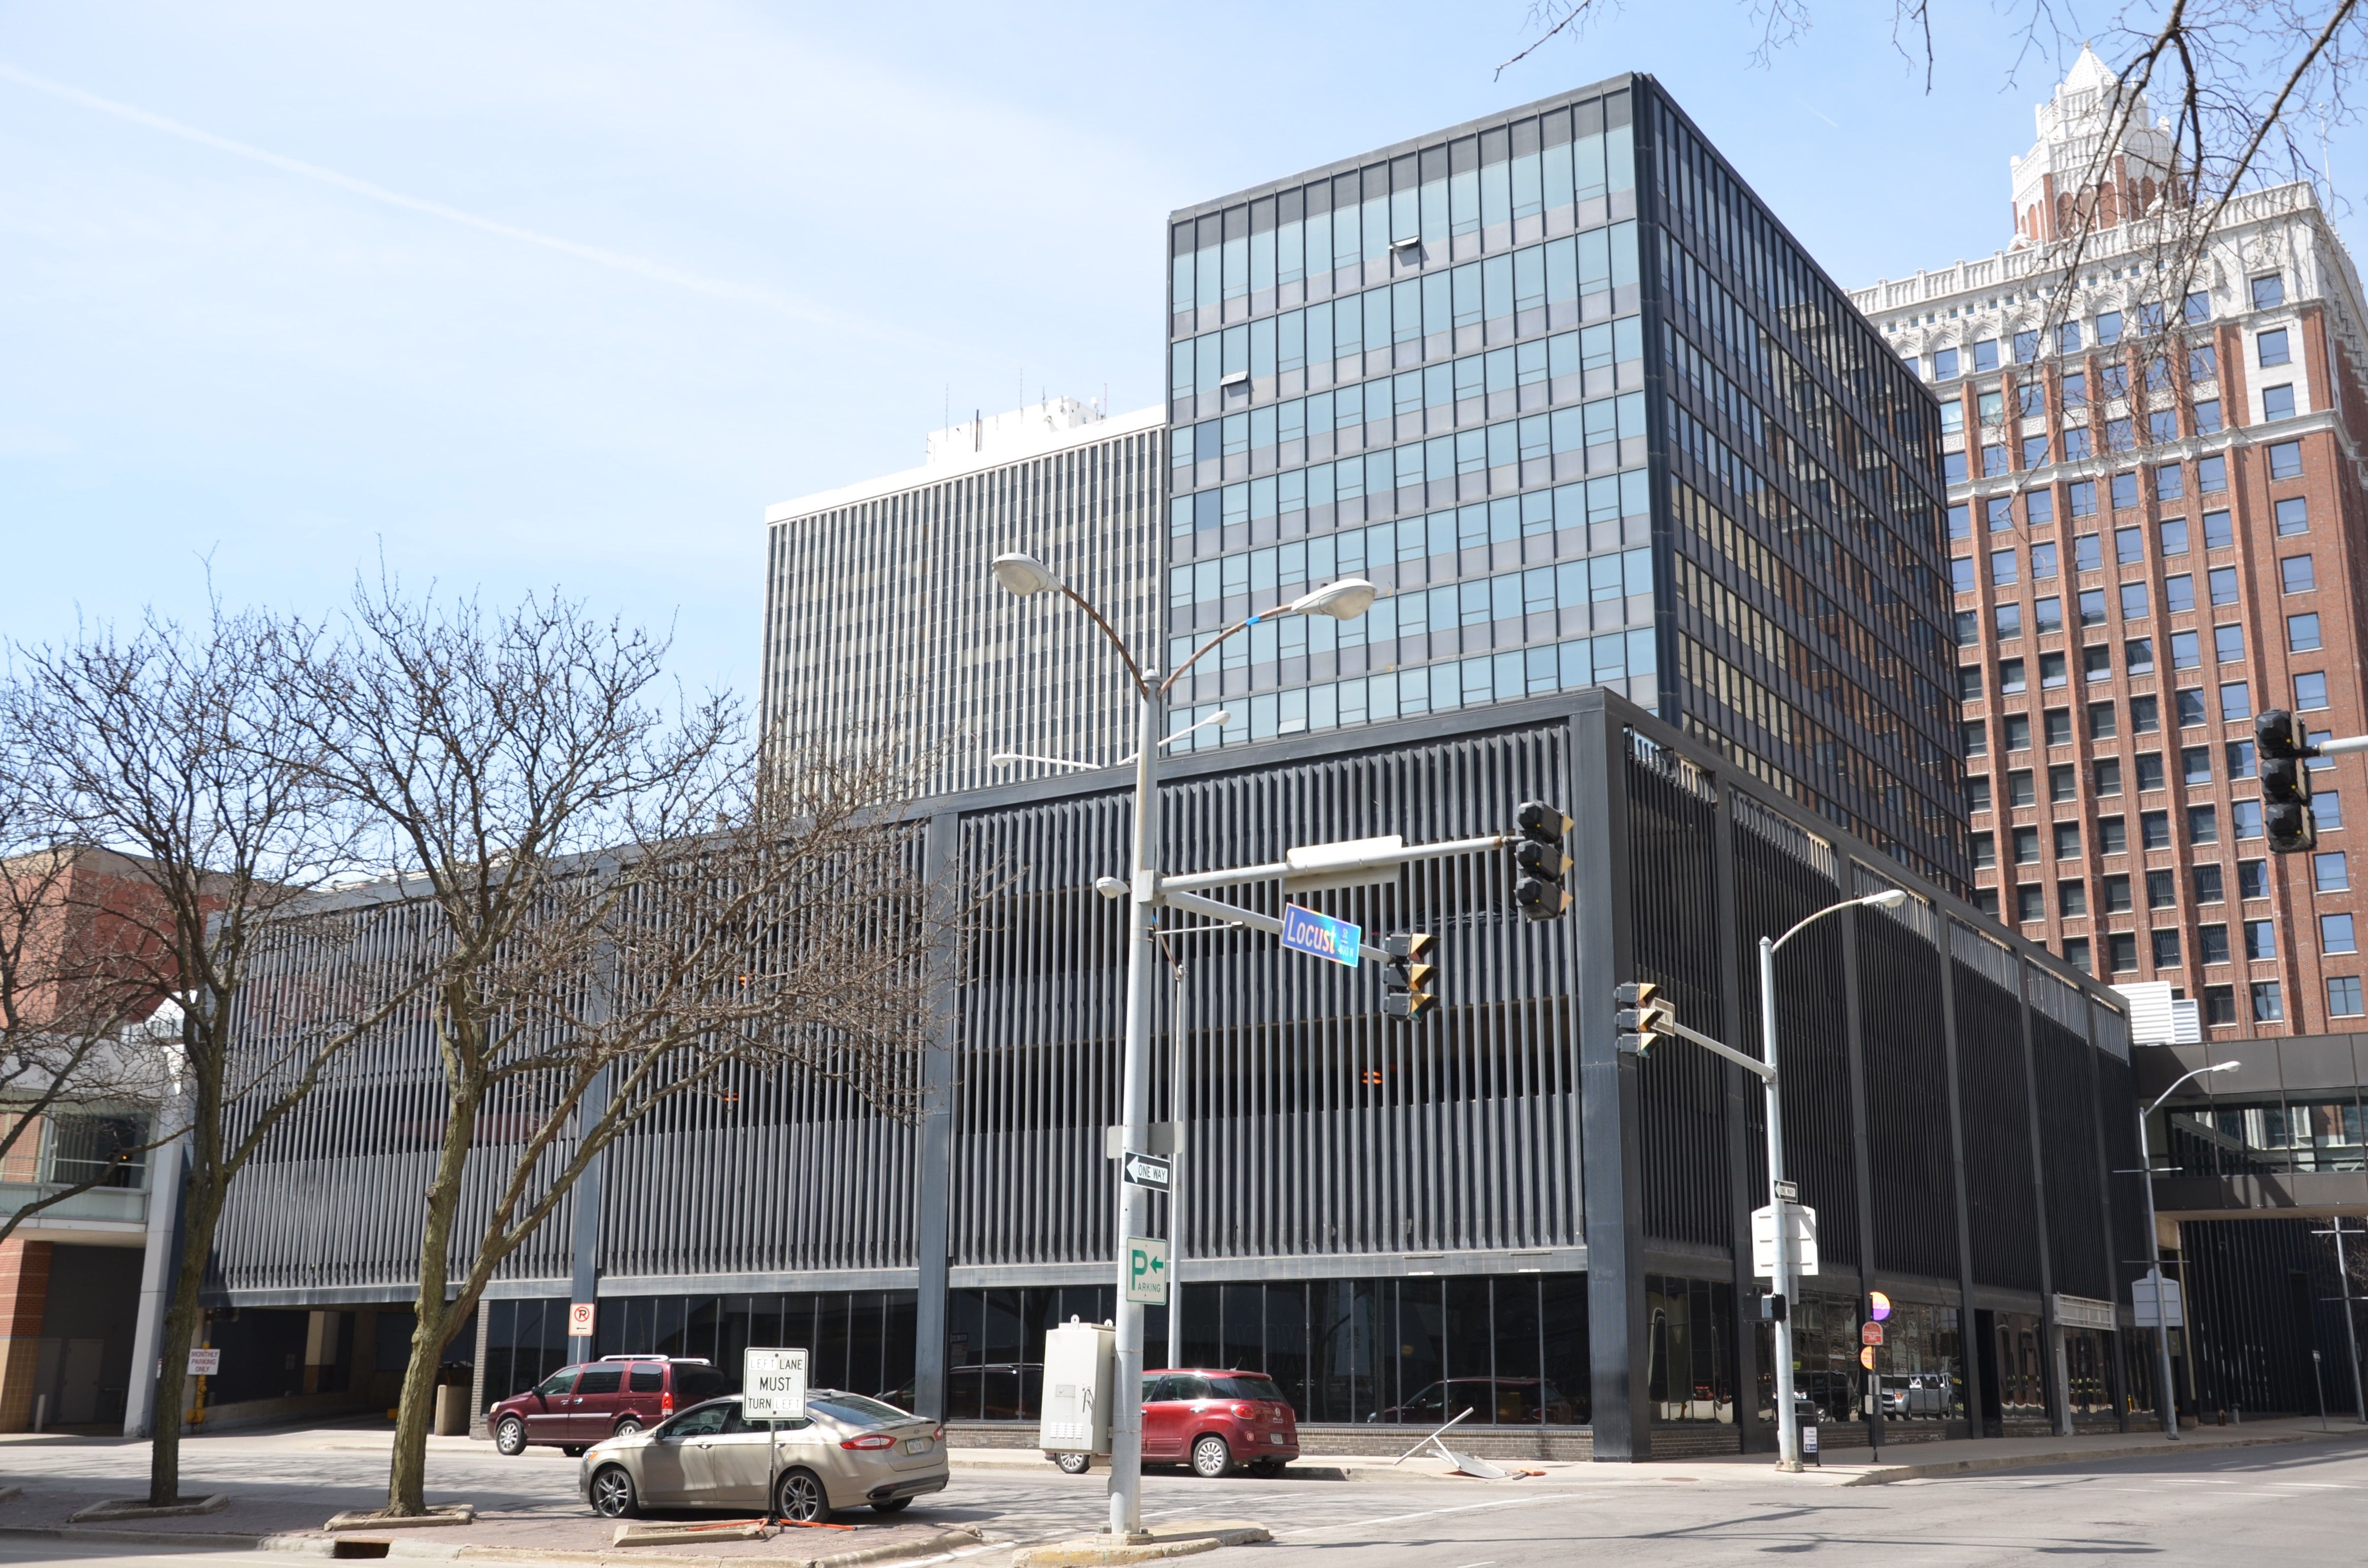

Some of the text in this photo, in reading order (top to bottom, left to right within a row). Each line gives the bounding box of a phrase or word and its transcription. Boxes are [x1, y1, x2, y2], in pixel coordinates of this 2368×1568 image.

[1287, 911, 1348, 954] Locust St
[1338, 943, 1349, 957] 400
[1138, 1164, 1166, 1181] ONE WAY
[751, 1359, 803, 1370] LEFT LANE
[759, 1377, 791, 1391] MUST
[748, 1398, 799, 1409] TURN LEFT
